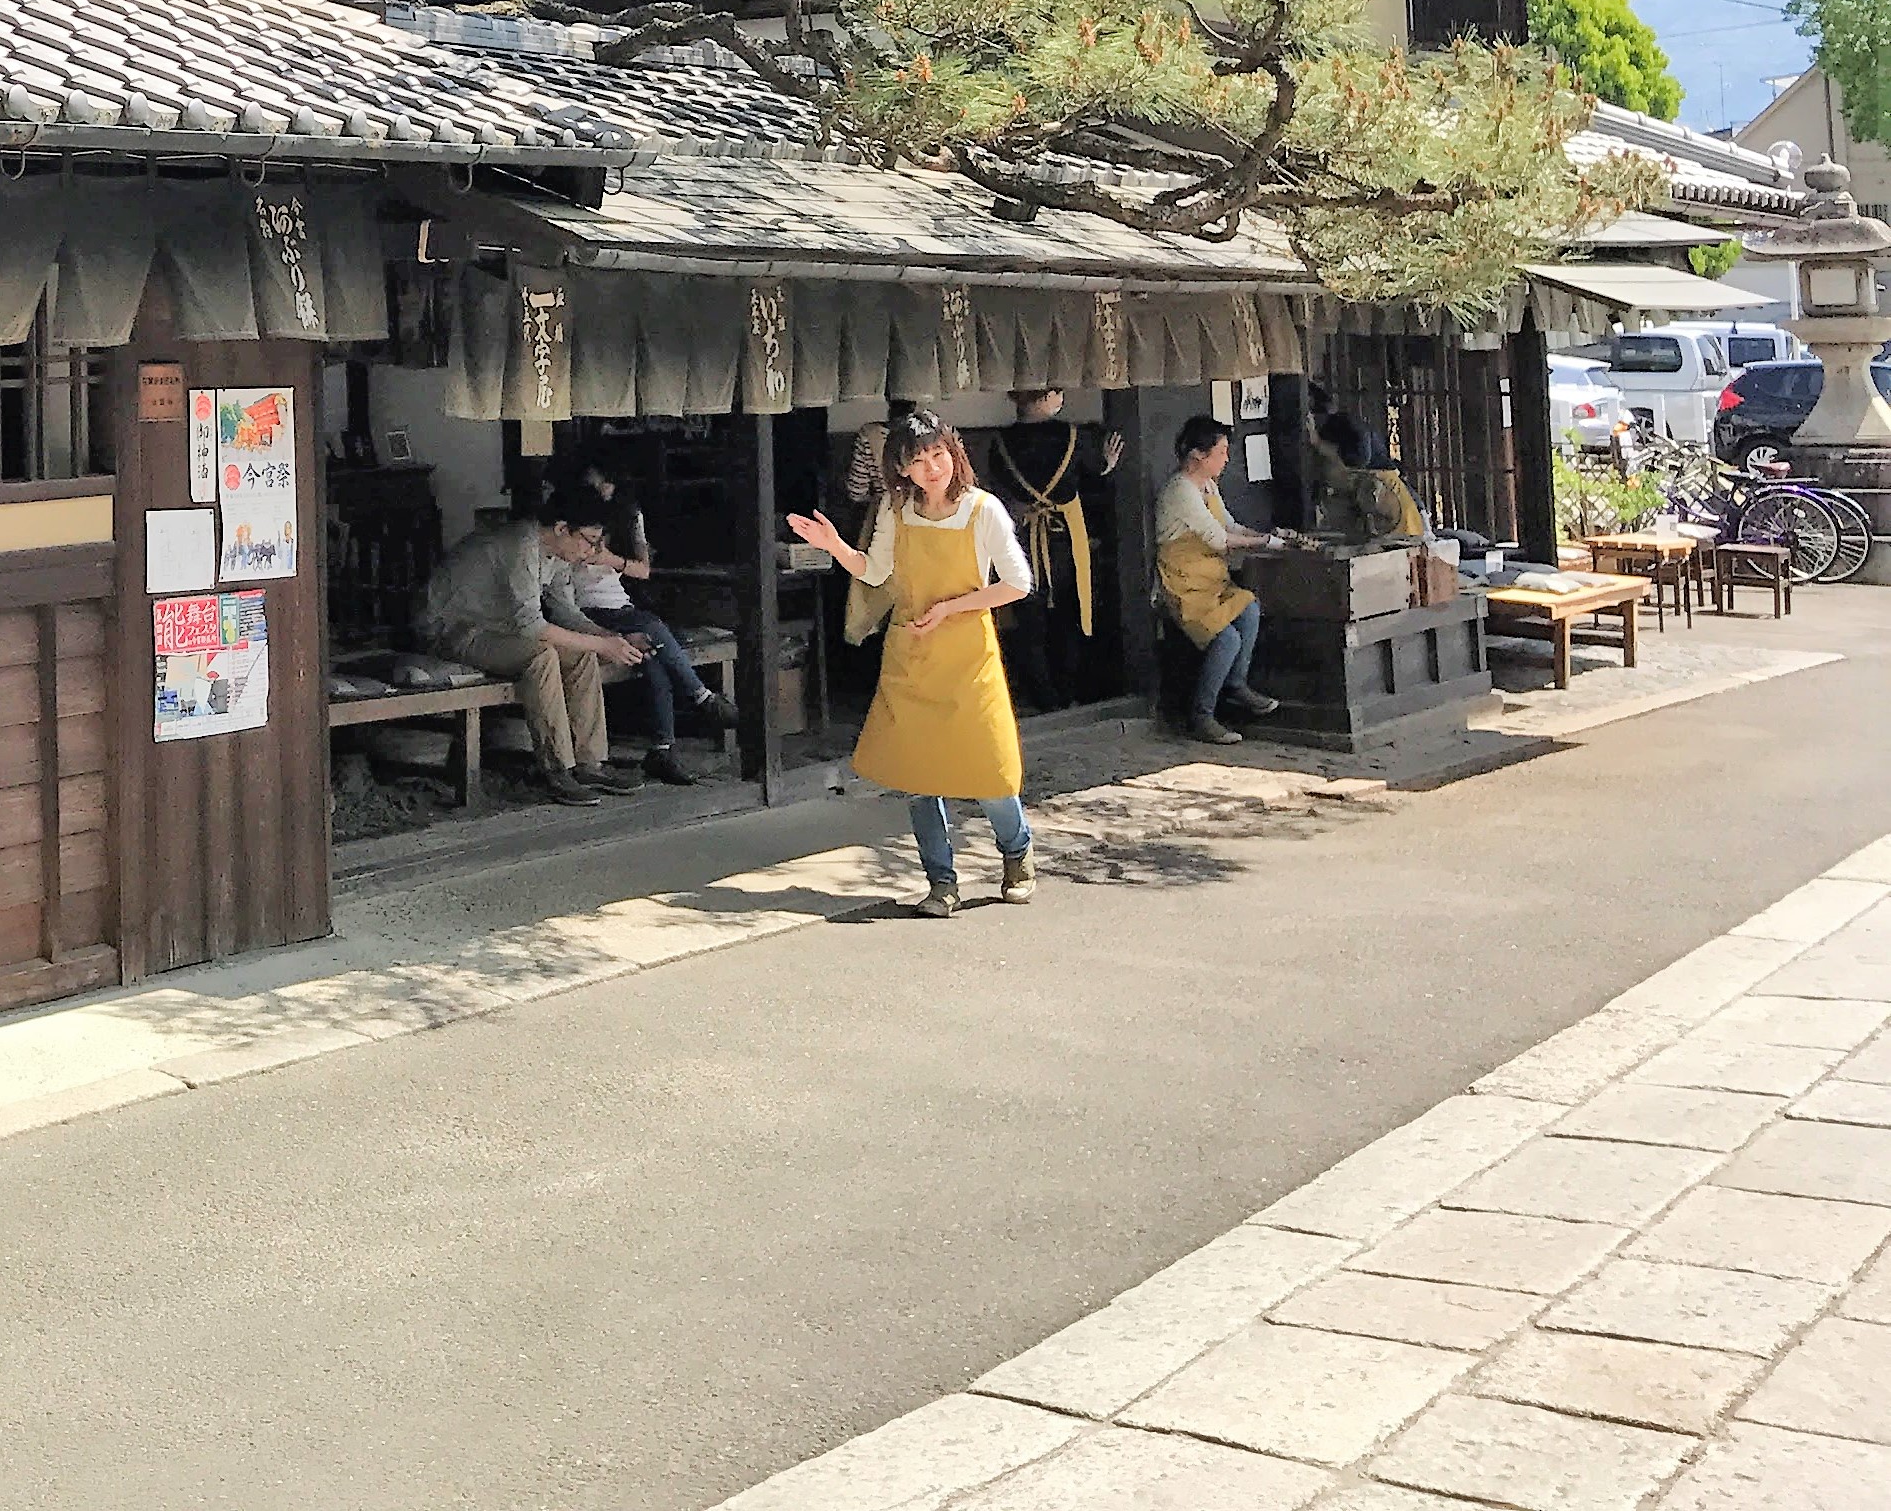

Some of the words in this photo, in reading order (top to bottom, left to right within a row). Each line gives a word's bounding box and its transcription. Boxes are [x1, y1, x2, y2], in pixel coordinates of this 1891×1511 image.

[529, 292, 555, 408] 一文字屋
[242, 462, 290, 489] 今宮祭
